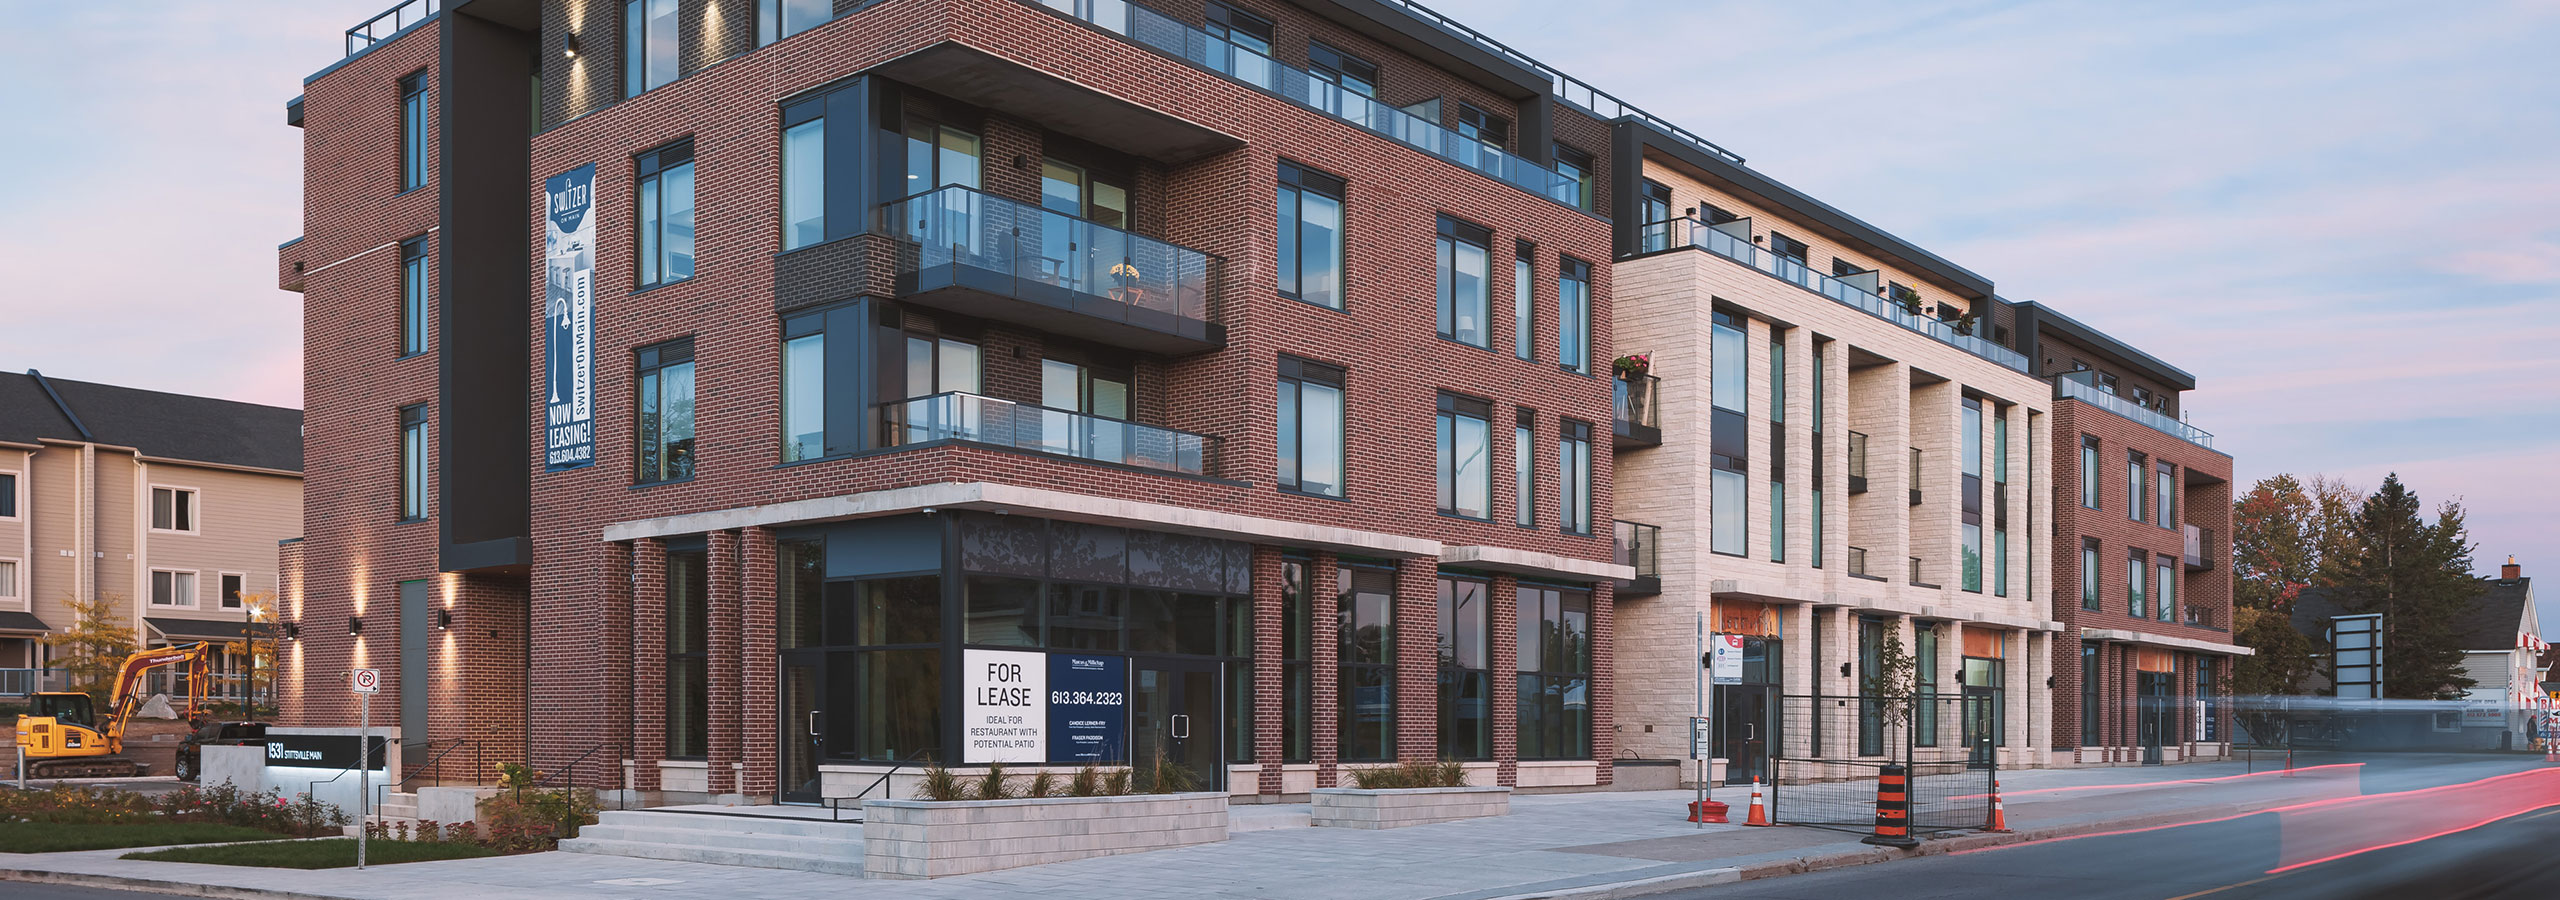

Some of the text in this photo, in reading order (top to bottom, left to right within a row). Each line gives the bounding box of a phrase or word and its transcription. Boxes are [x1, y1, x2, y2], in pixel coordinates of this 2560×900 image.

[554, 178, 587, 214] SWITZER
[568, 213, 580, 221] MAIN
[575, 276, 585, 416] SwitzerOnMain.com
[549, 402, 571, 427] NOW
[549, 421, 591, 449] LEASING!
[549, 445, 591, 464] 613.604.4382
[988, 663, 1022, 682] FOR
[977, 687, 1031, 706] LEASE
[1051, 690, 1123, 705] 613.364.2323
[987, 715, 1023, 724] IDEAL FOR
[970, 728, 1038, 736] RESTAURANT WITH
[267, 742, 284, 759] 1531
[309, 751, 323, 760] MAIN
[974, 740, 1035, 749] POTENTIAL PATIO
